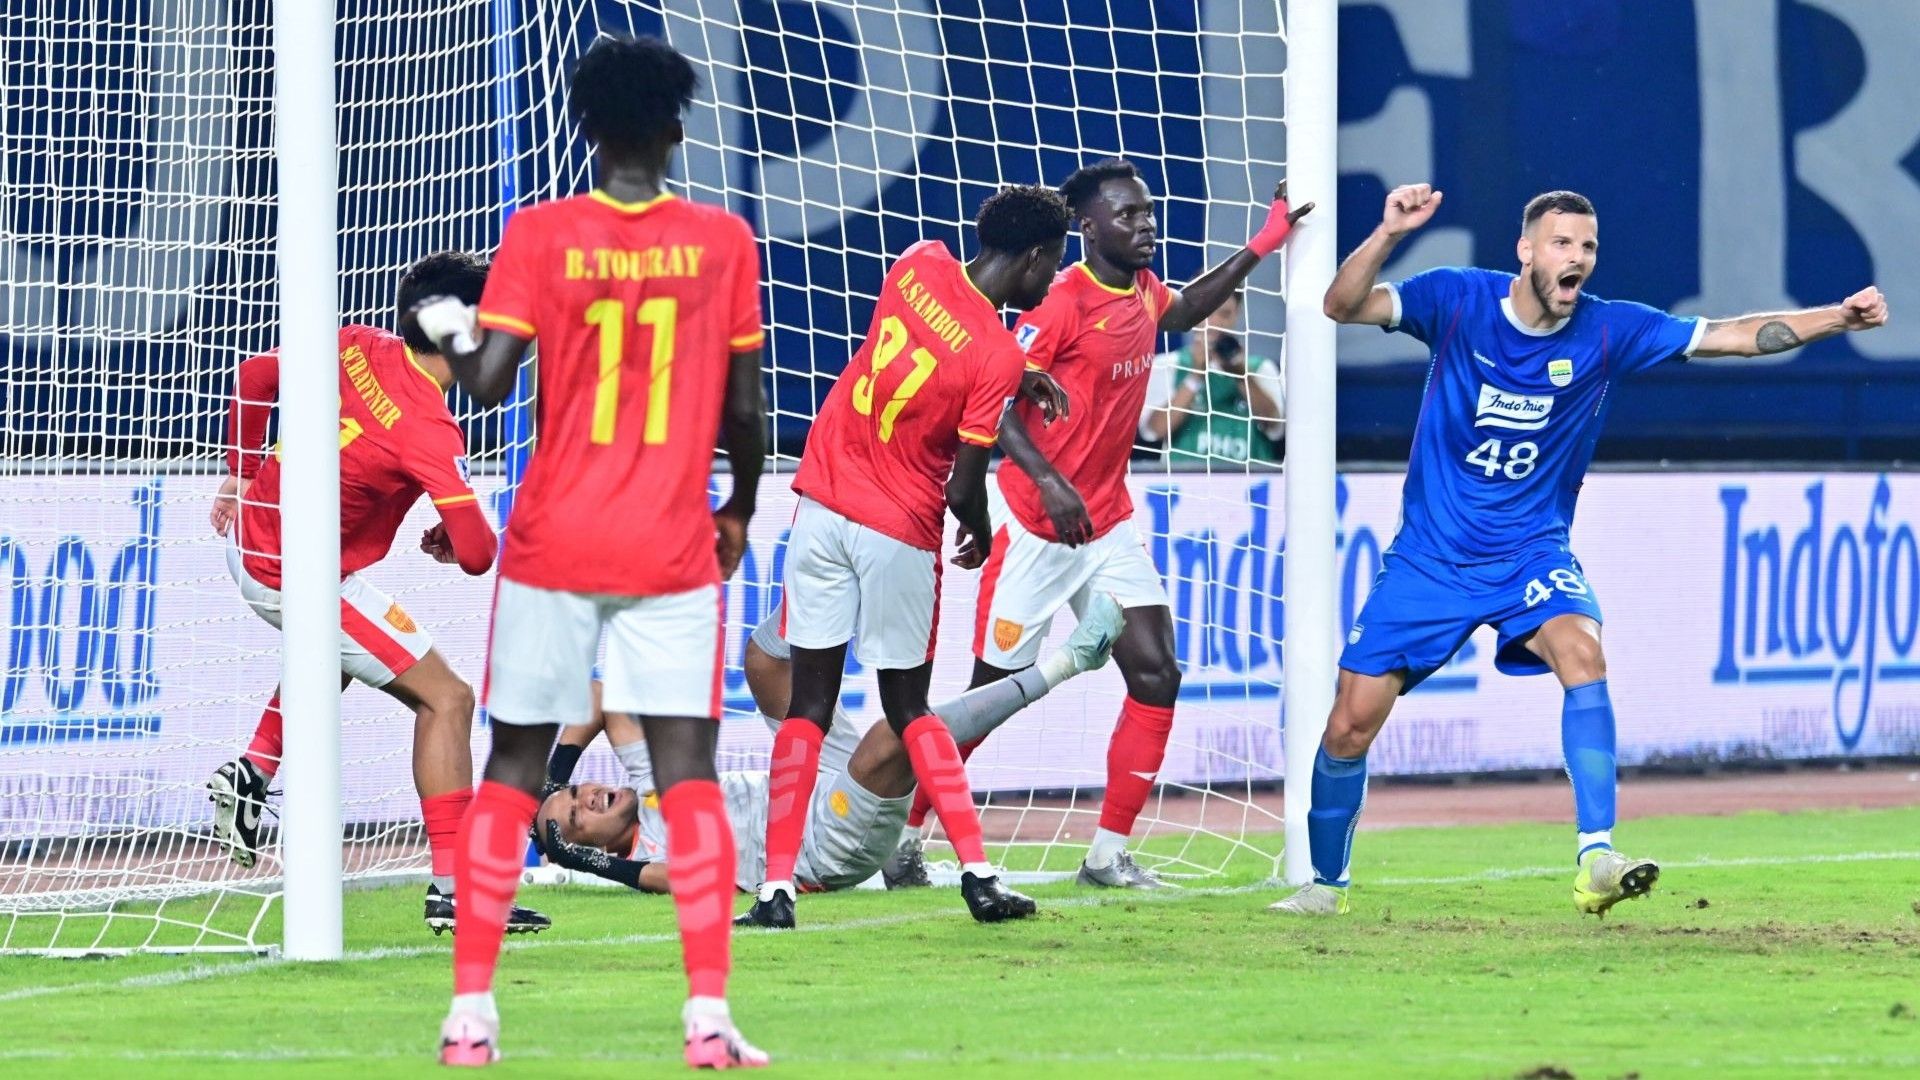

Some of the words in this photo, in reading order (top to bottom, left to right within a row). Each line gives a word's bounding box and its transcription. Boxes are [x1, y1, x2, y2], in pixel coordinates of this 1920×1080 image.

[565, 244, 703, 281] B.TOURAY
[897, 267, 973, 353] D.SAMBOU
[340, 345, 402, 430] SCHAFFNER
[584, 296, 678, 445] 11
[852, 315, 938, 444] 91
[1465, 438, 1539, 480] 48
[1523, 568, 1587, 607] 48
[1712, 473, 1920, 750] Indofo
